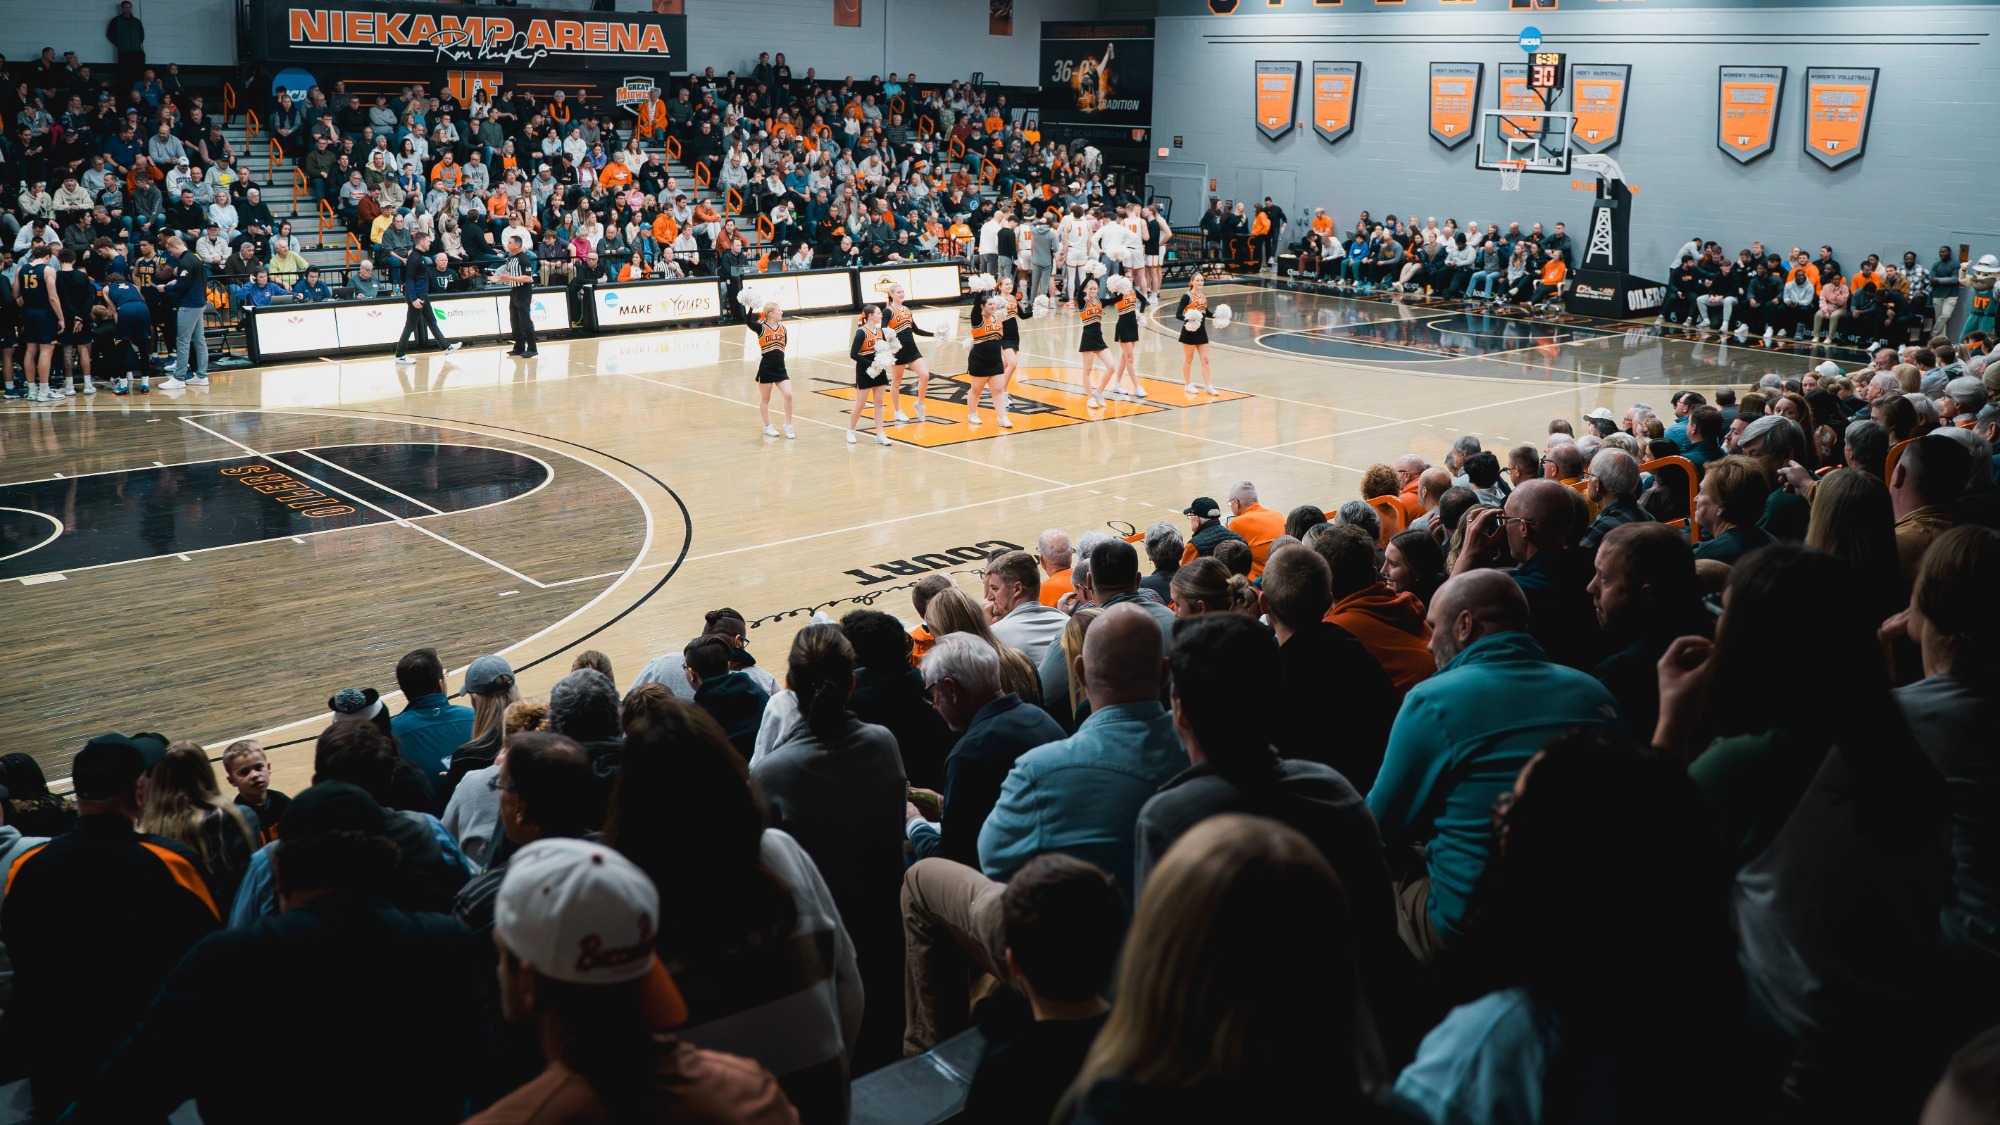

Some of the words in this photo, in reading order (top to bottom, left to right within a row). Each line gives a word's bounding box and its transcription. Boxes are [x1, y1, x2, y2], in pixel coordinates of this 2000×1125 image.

[289, 8, 514, 48] NIEKAMP
[527, 19, 669, 53] ARENA
[1535, 53, 1559, 65] 6:30
[1532, 65, 1555, 86] 30
[627, 83, 650, 91] GREAT
[616, 88, 651, 101] MIDWES
[1097, 99, 1140, 111] TRADITION
[1023, 230, 1033, 241] 12
[1077, 226, 1083, 237] 1
[23, 274, 39, 289] 15
[141, 273, 152, 287] 13
[1627, 285, 1668, 311] OILERS
[1973, 296, 1991, 310] UF
[619, 304, 653, 316] MAKE
[669, 294, 710, 317] YOURS
[220, 465, 356, 519] OILERS
[842, 540, 1025, 586] COURT
